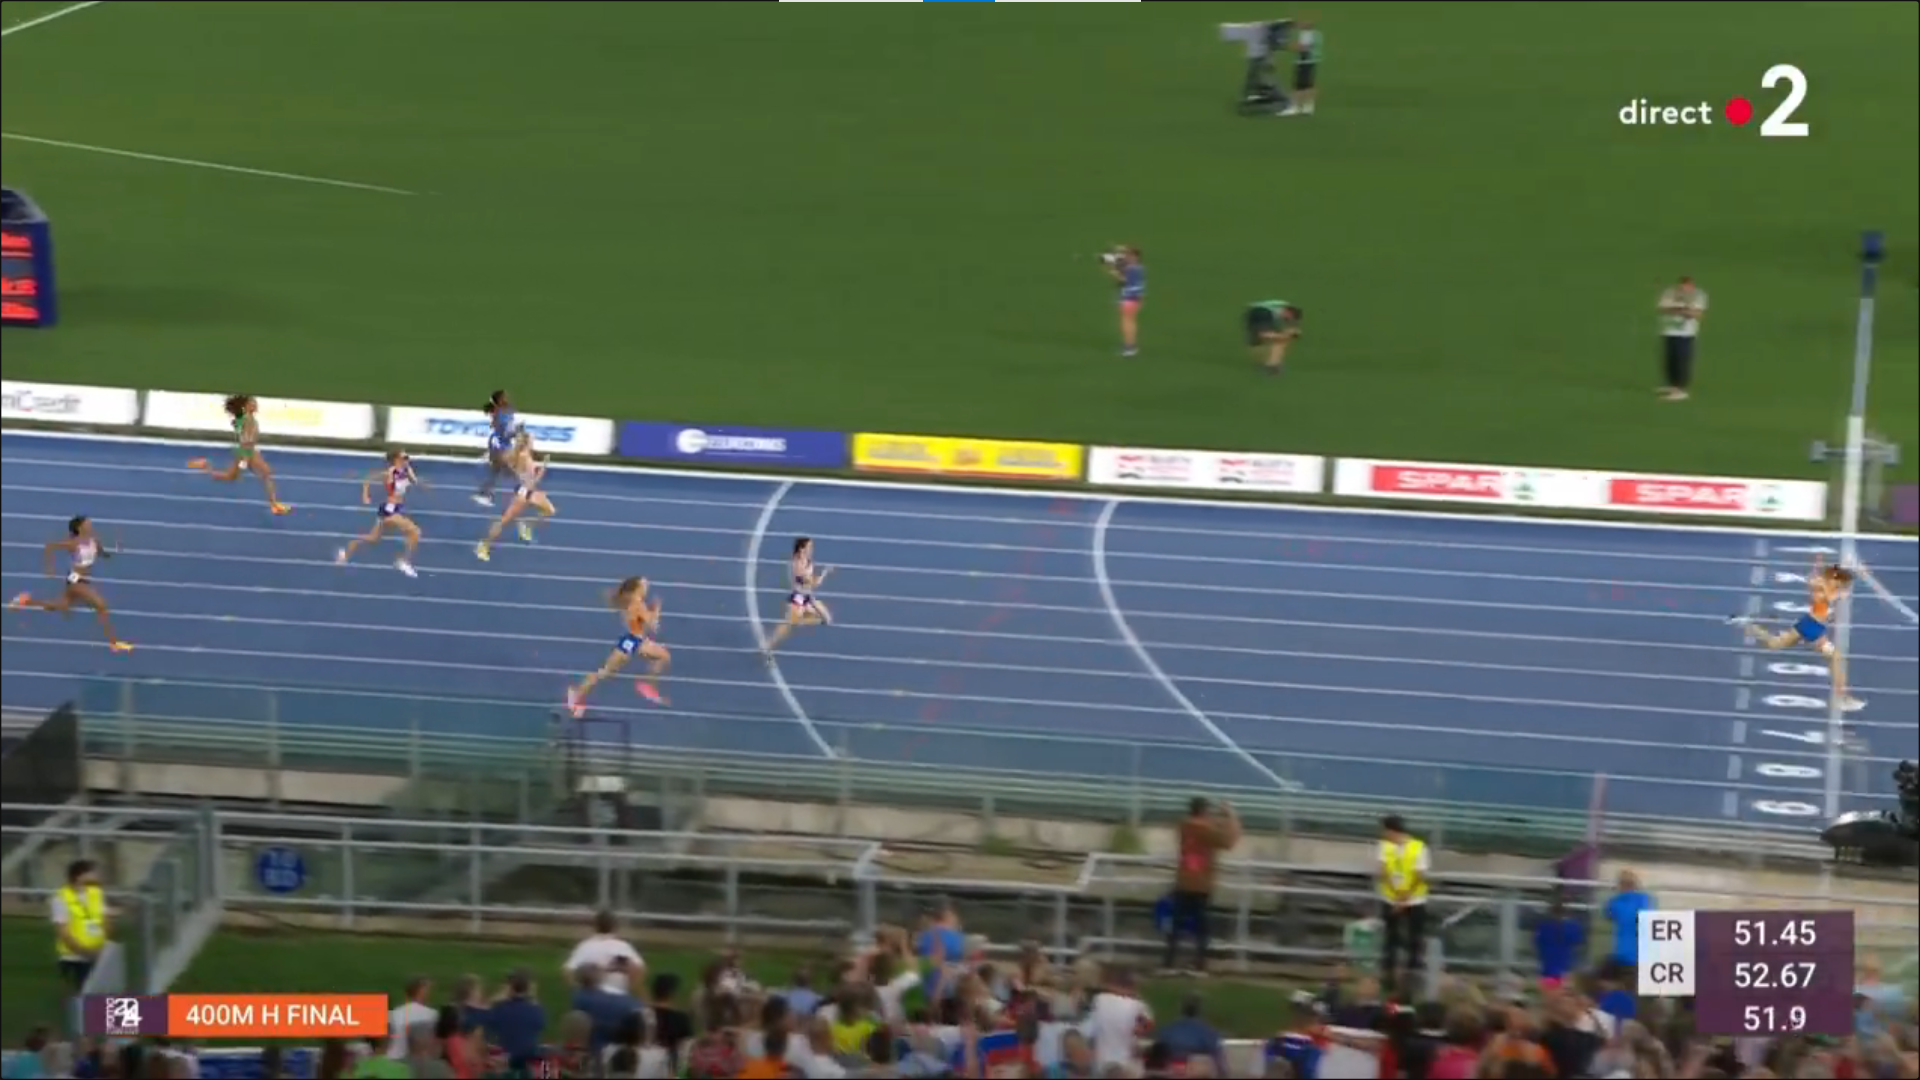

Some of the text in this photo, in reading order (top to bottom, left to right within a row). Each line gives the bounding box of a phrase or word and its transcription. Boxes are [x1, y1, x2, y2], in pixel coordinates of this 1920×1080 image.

[1397, 469, 1502, 495] SPAR
[1635, 482, 1746, 508] SPAR
[1760, 729, 1824, 744] 7
[1755, 763, 1823, 778] 8
